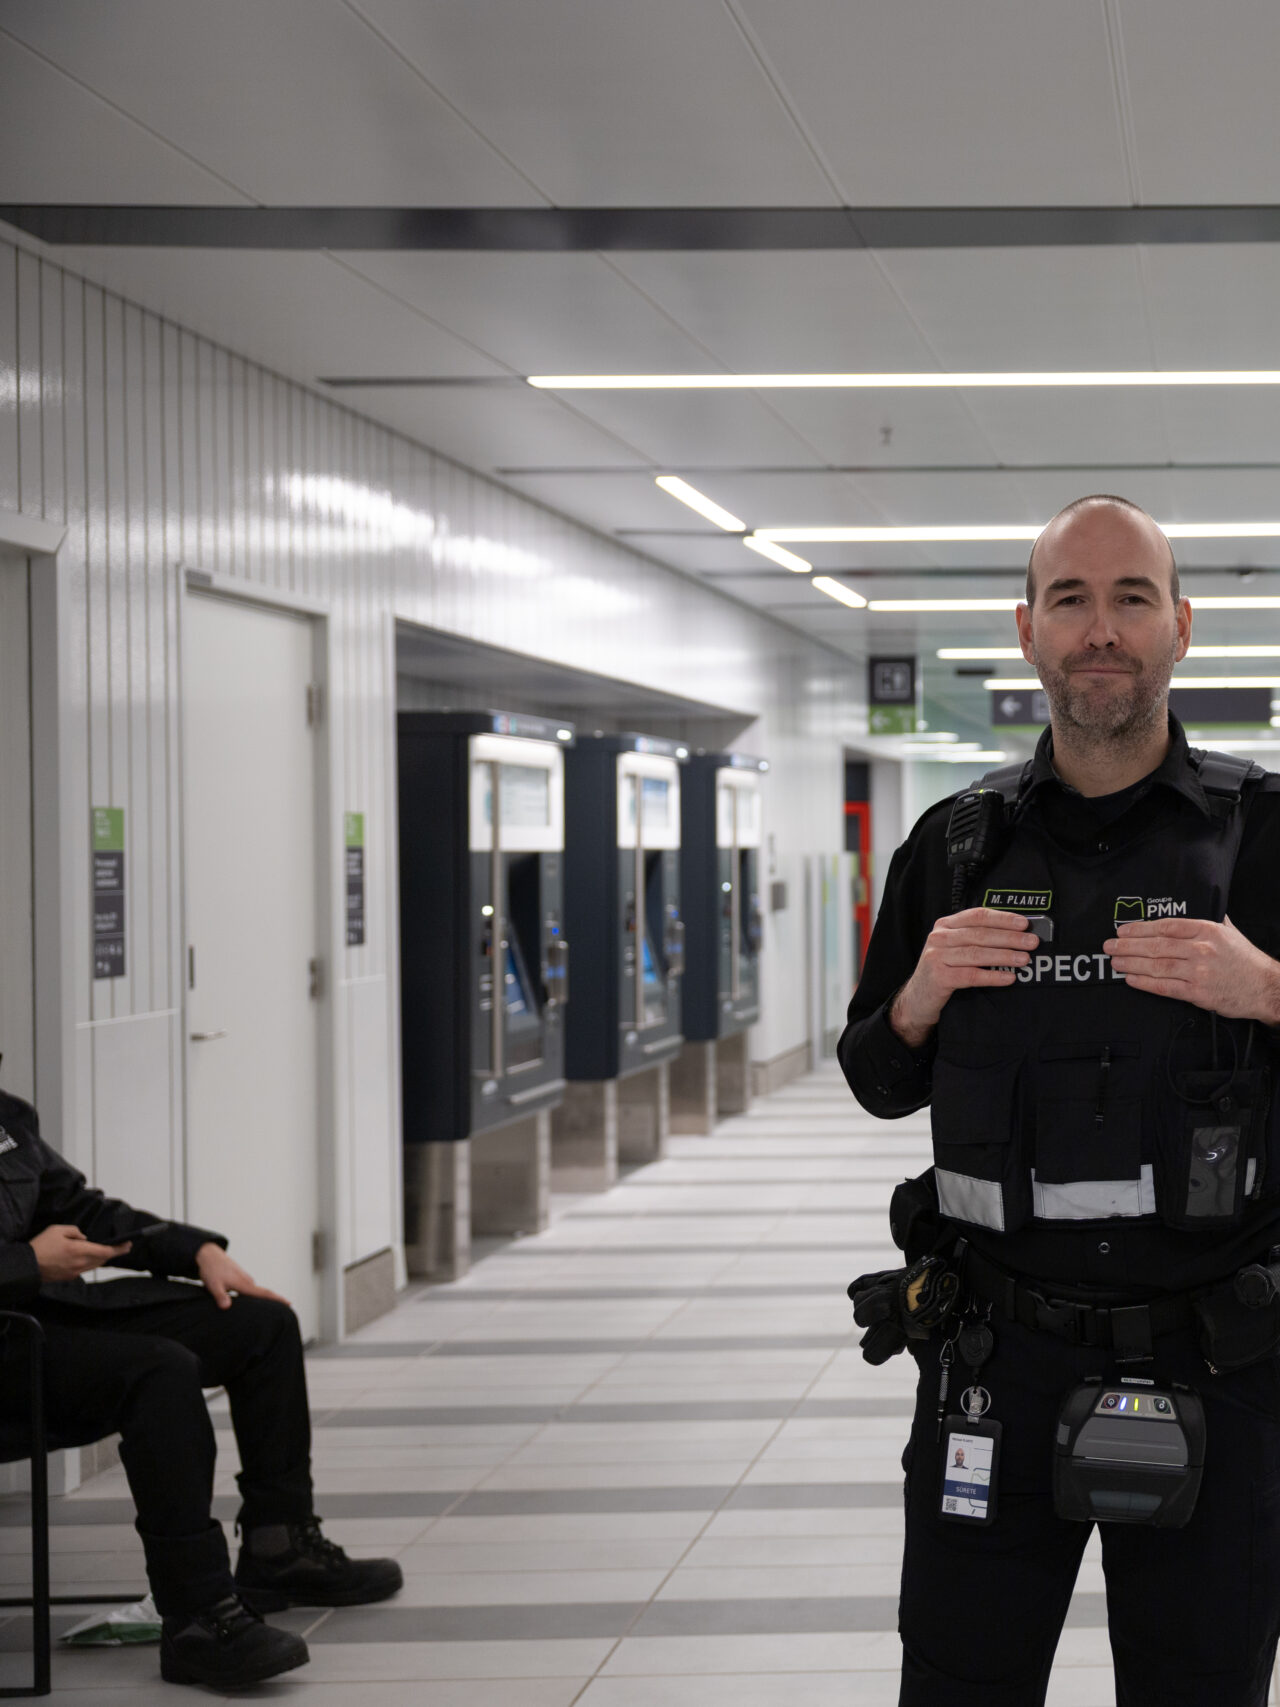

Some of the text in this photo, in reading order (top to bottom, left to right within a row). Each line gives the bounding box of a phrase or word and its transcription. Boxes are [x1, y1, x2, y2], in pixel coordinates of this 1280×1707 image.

[991, 894, 1047, 906] M. PLANTE
[1146, 896, 1173, 904] Groupe
[1147, 901, 1187, 918] PMM
[990, 953, 1128, 983] SPECT
